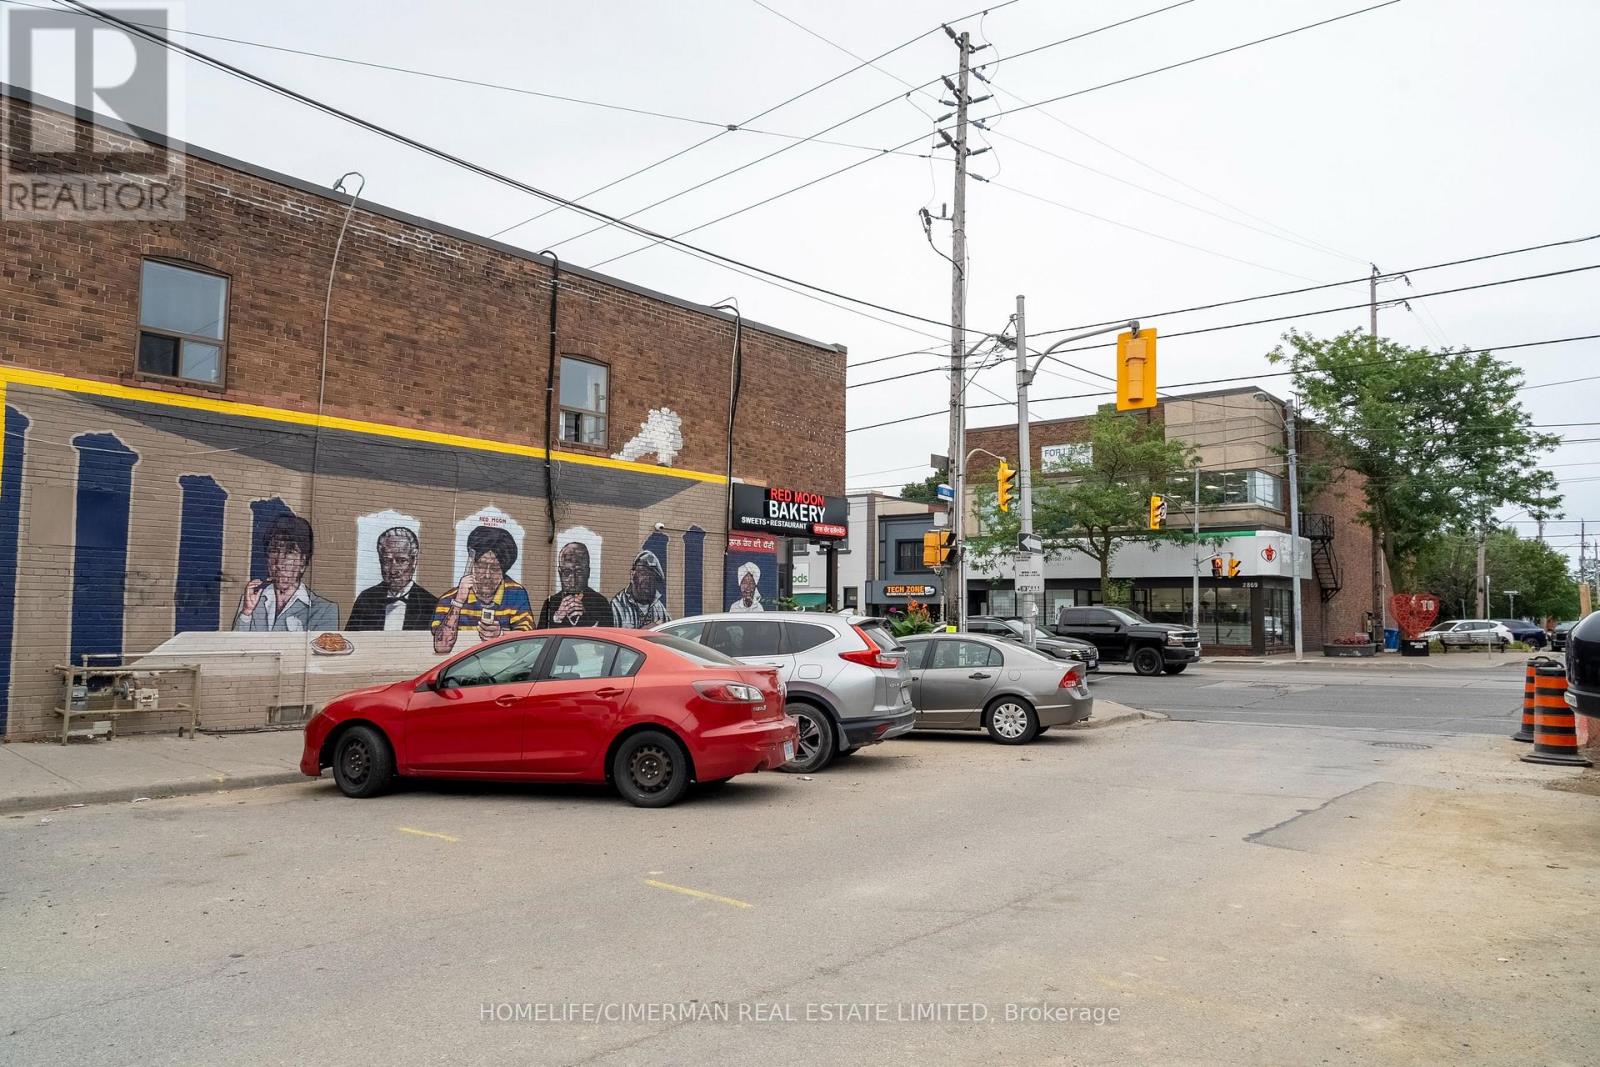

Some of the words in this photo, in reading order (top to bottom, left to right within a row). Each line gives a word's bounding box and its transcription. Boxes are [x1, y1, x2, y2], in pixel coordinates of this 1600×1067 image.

[1044, 448, 1061, 457] FOR
[770, 487, 792, 502] RED
[795, 490, 825, 506] MOON
[769, 500, 826, 523] BAKERY
[906, 585, 925, 593] ZONE
